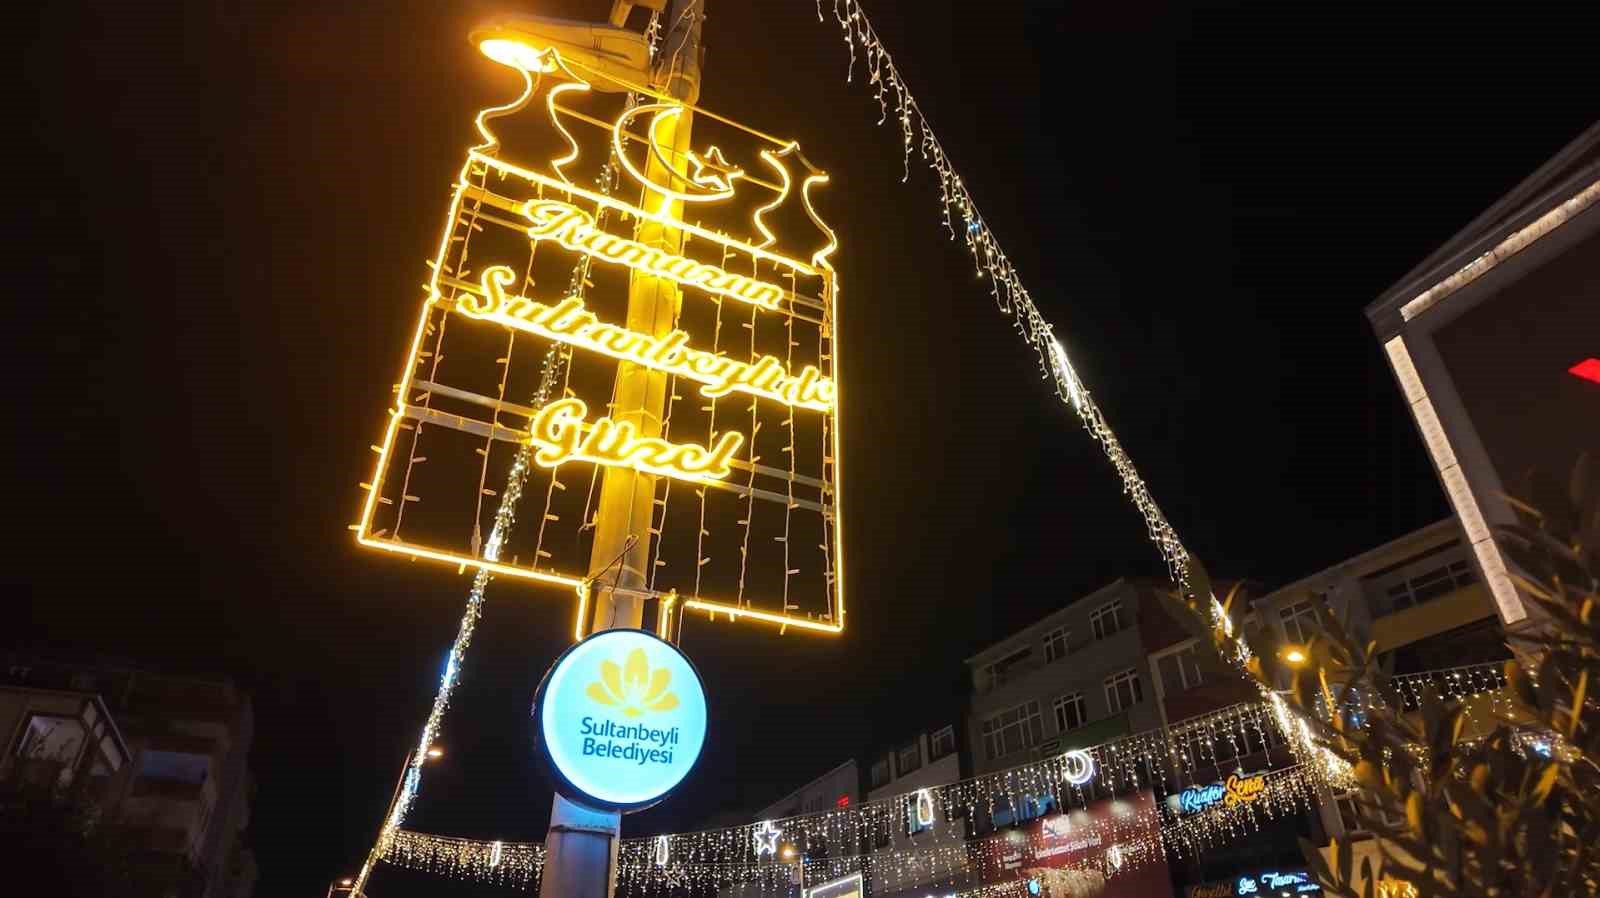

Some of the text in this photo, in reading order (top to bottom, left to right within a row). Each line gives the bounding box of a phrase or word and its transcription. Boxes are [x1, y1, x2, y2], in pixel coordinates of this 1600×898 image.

[523, 198, 785, 311] Ramazan
[580, 716, 679, 747] Sultanbeyli
[582, 737, 673, 765] Belediyesi
